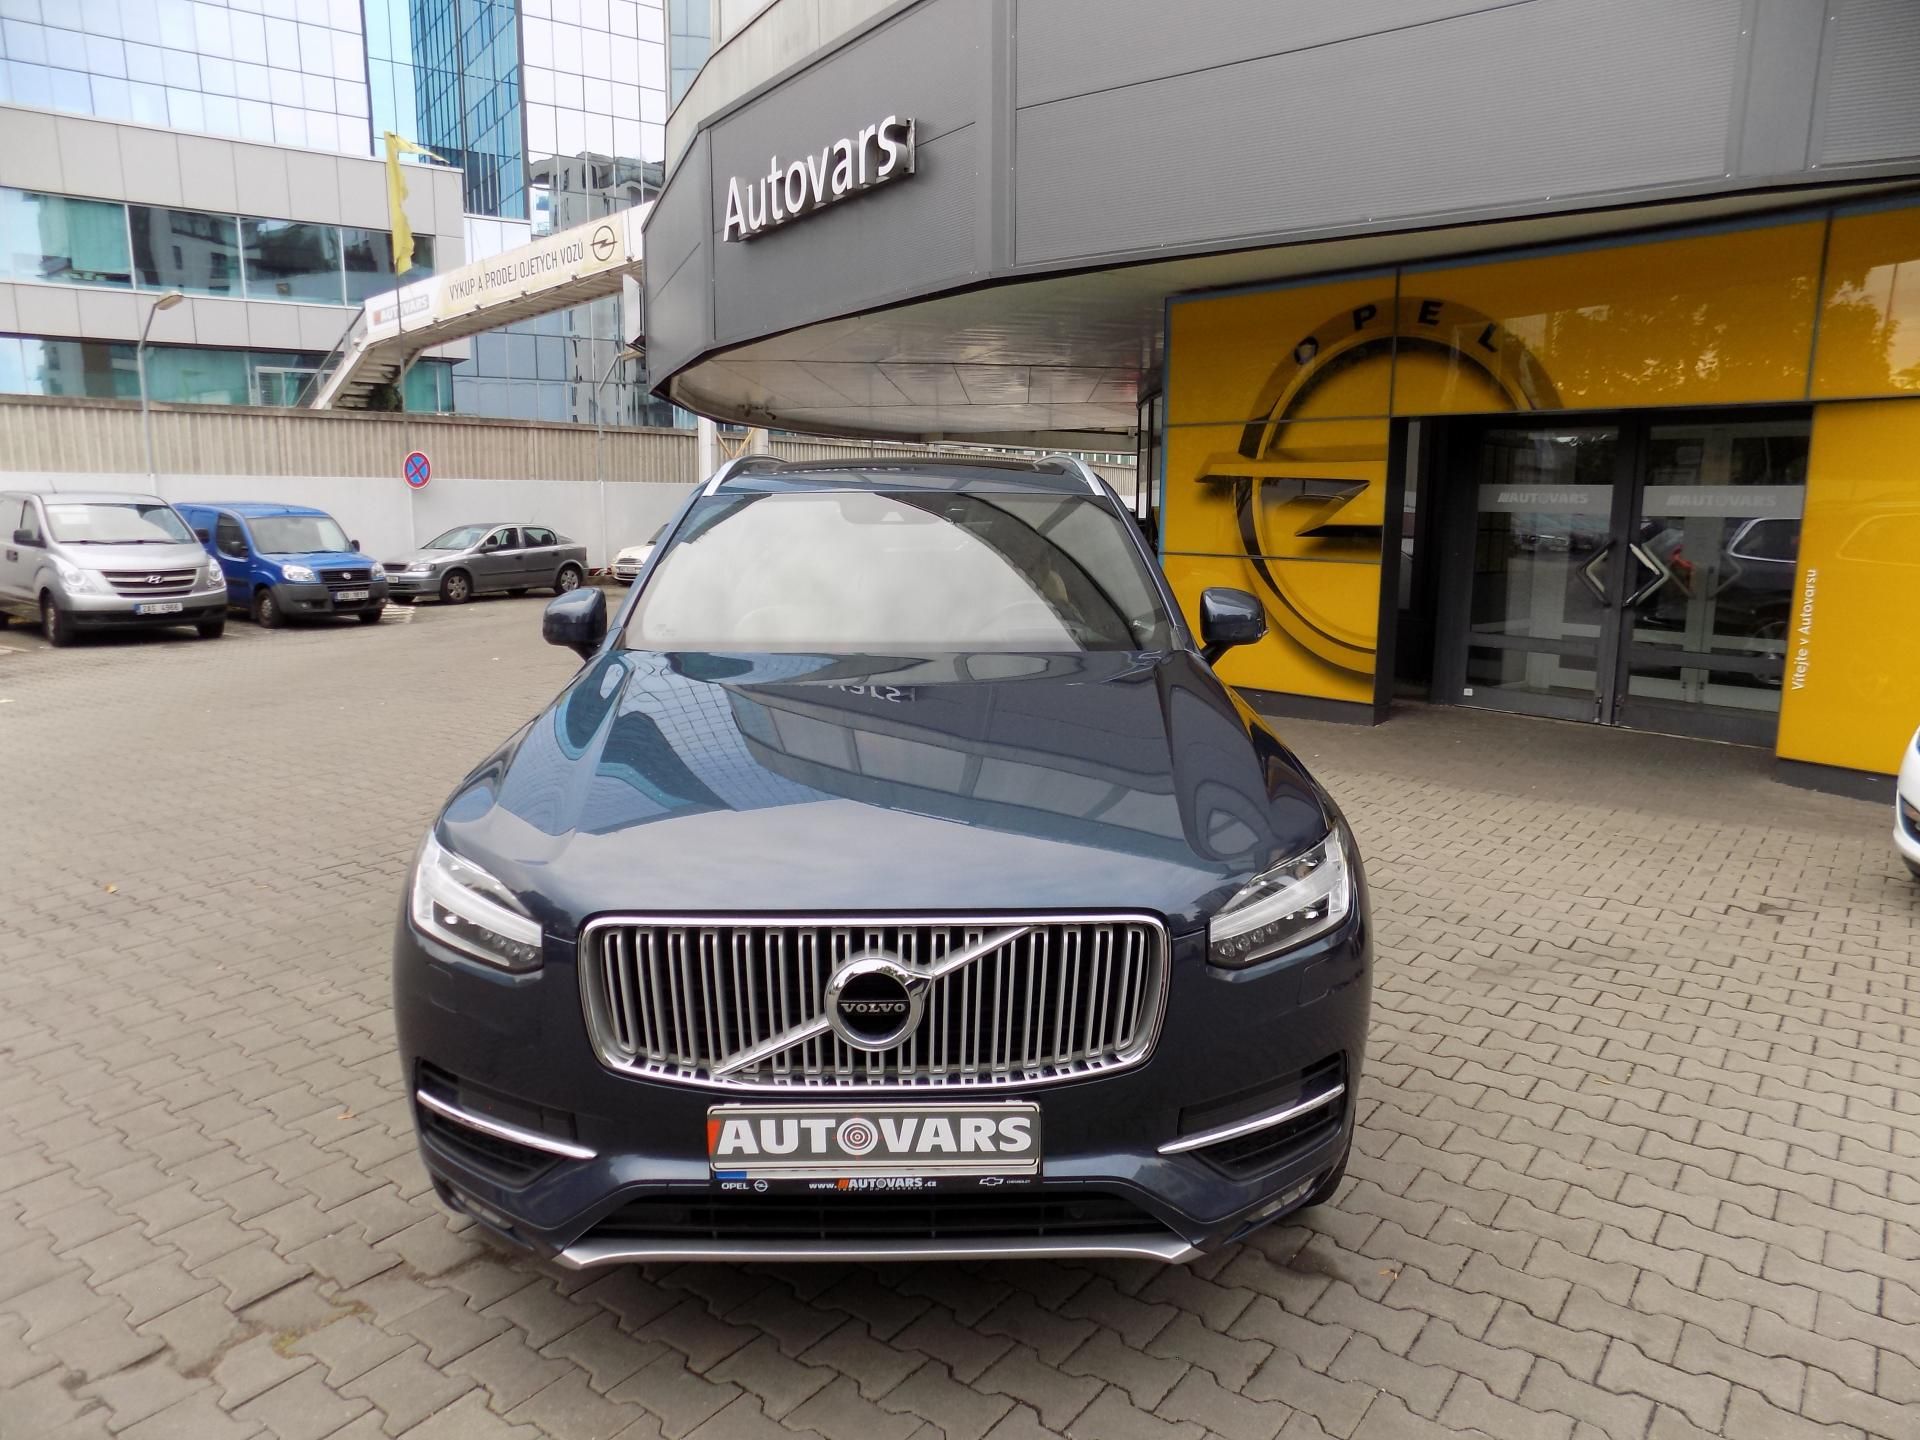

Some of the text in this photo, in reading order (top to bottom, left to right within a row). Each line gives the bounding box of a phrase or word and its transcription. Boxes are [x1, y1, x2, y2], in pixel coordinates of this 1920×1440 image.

[723, 115, 897, 242] Autovars
[478, 275, 484, 292] A
[485, 264, 517, 290] PRODEJ
[1294, 300, 1500, 366] OPEL
[1798, 568, 1817, 635] Autovarsu
[840, 1003, 906, 1013] VOLVO
[717, 1117, 1033, 1155] AUTOVARS
[721, 1182, 750, 1190] OPEL
